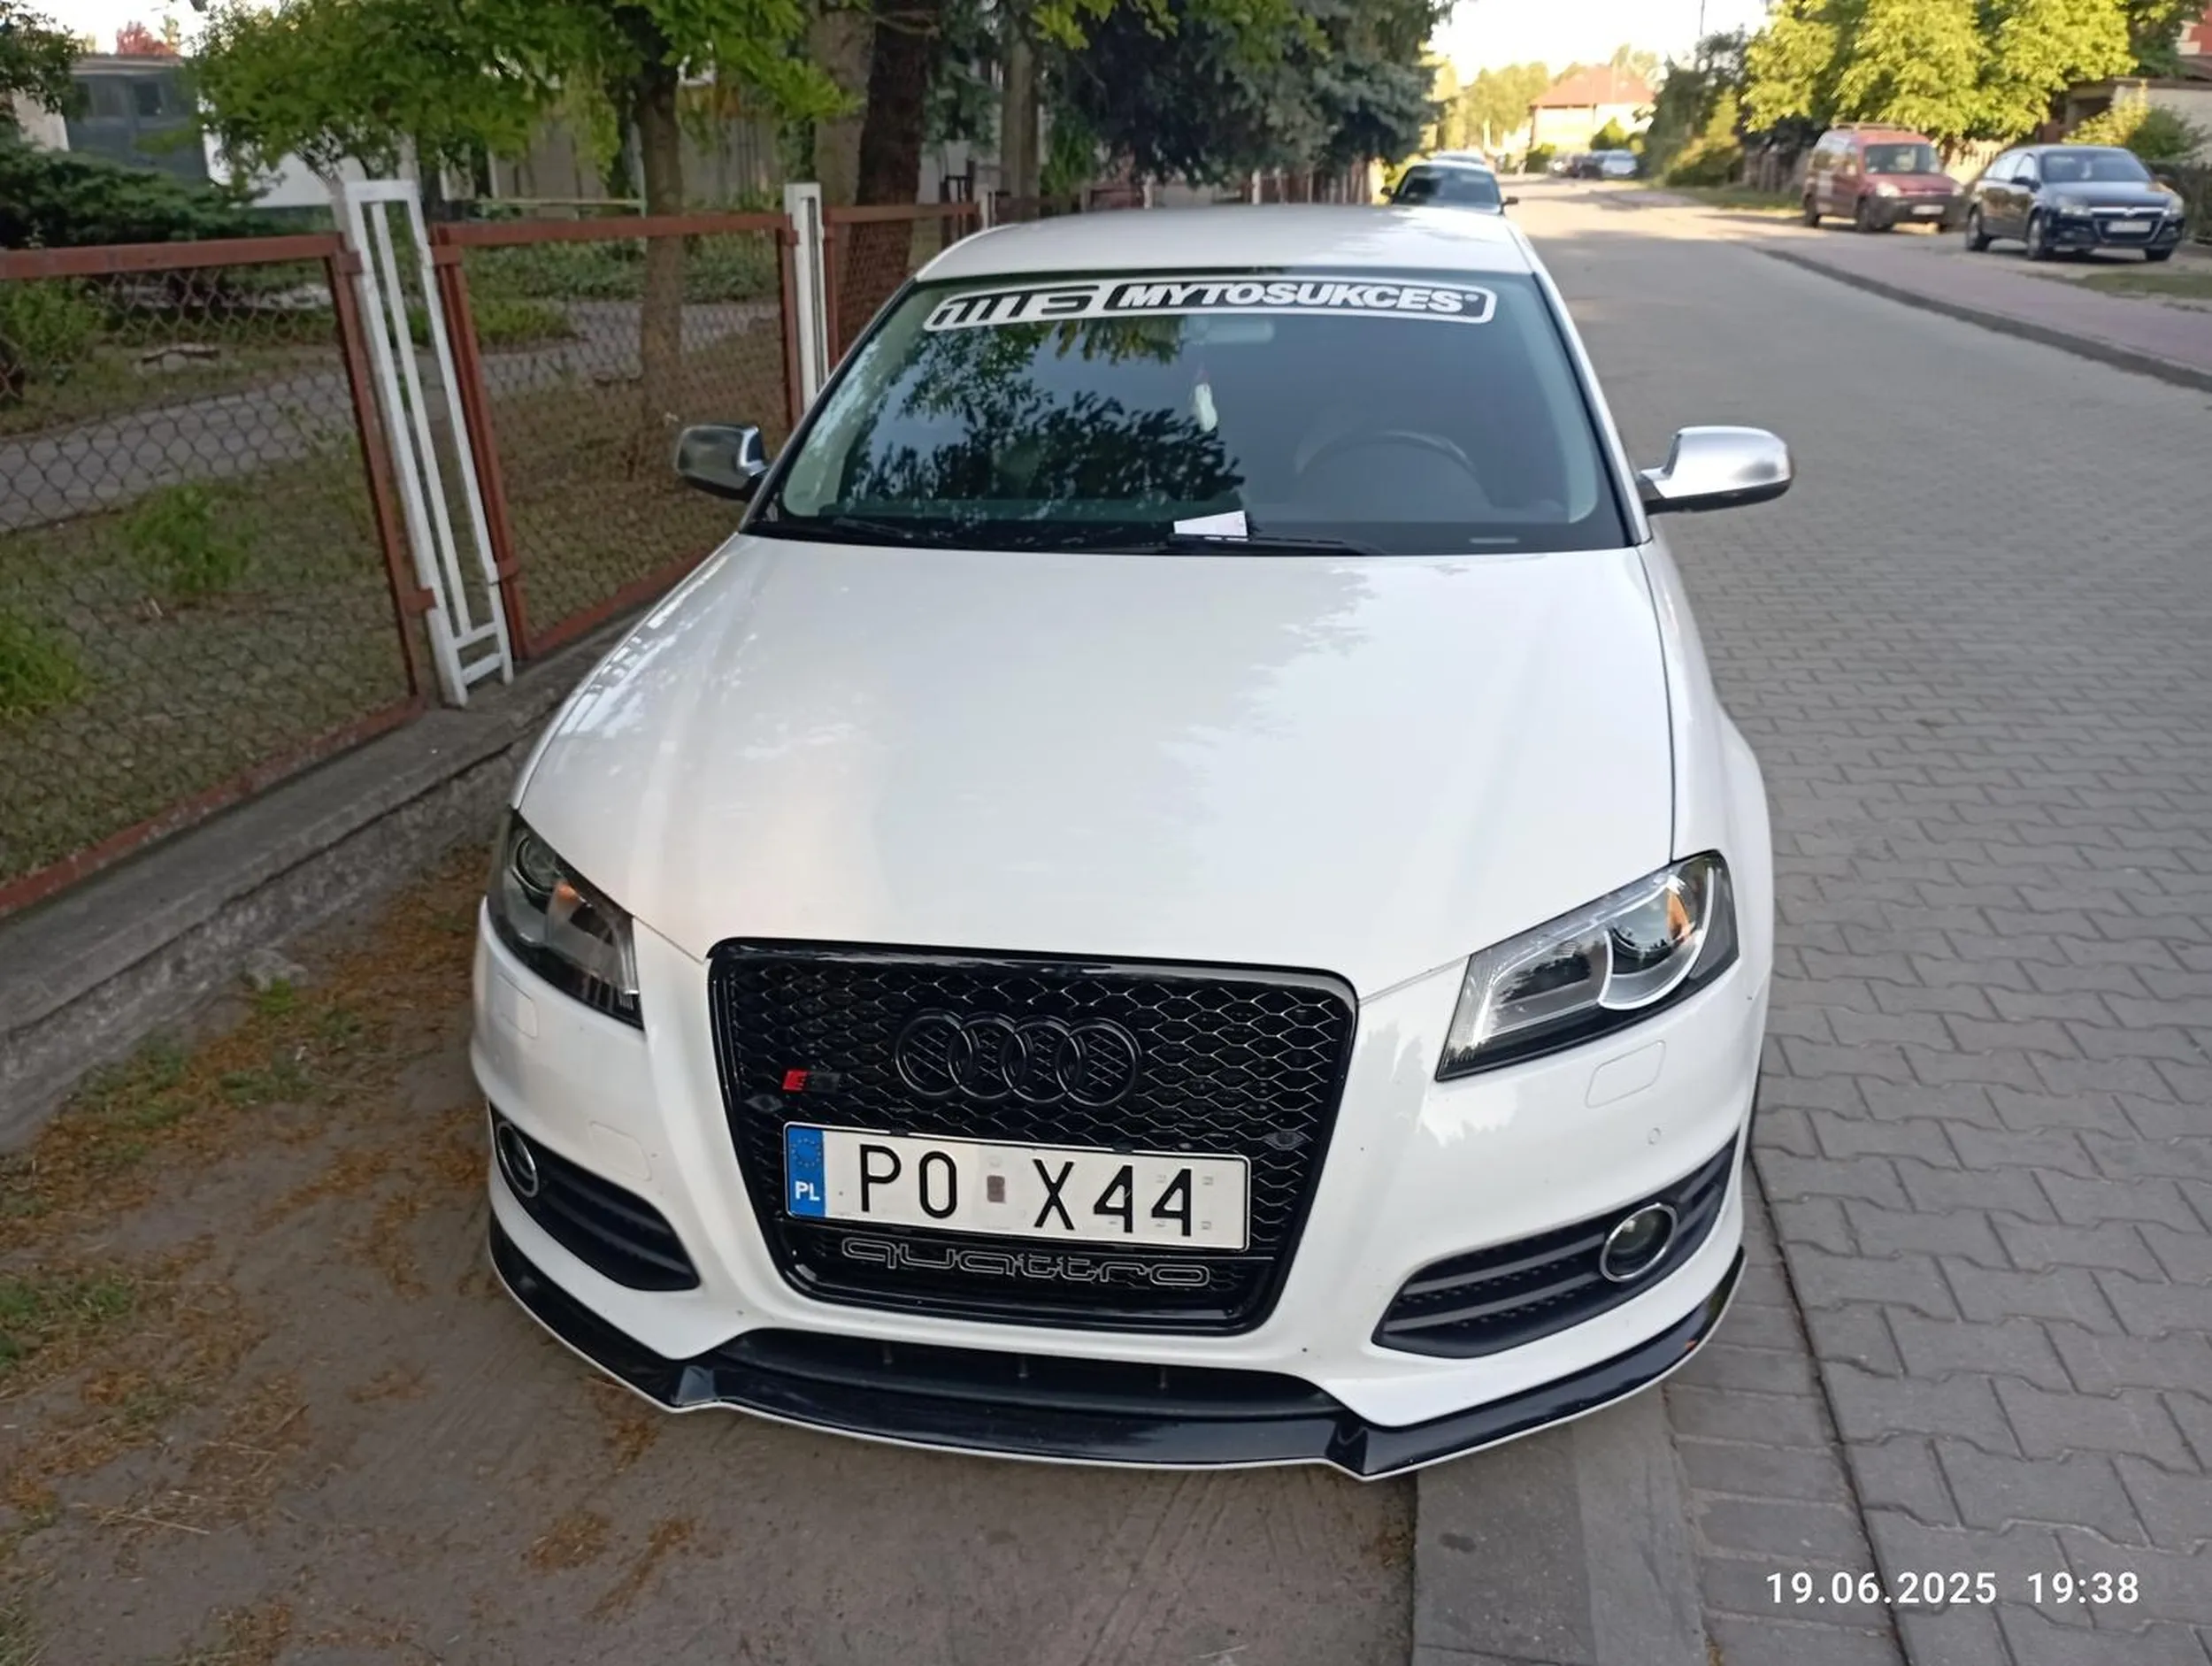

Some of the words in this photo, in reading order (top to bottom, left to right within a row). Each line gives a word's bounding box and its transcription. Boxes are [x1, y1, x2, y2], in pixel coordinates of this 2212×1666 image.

[795, 1181, 820, 1202] PL
[1033, 1158, 1192, 1237] X44
[841, 1237, 1210, 1287] quattro
